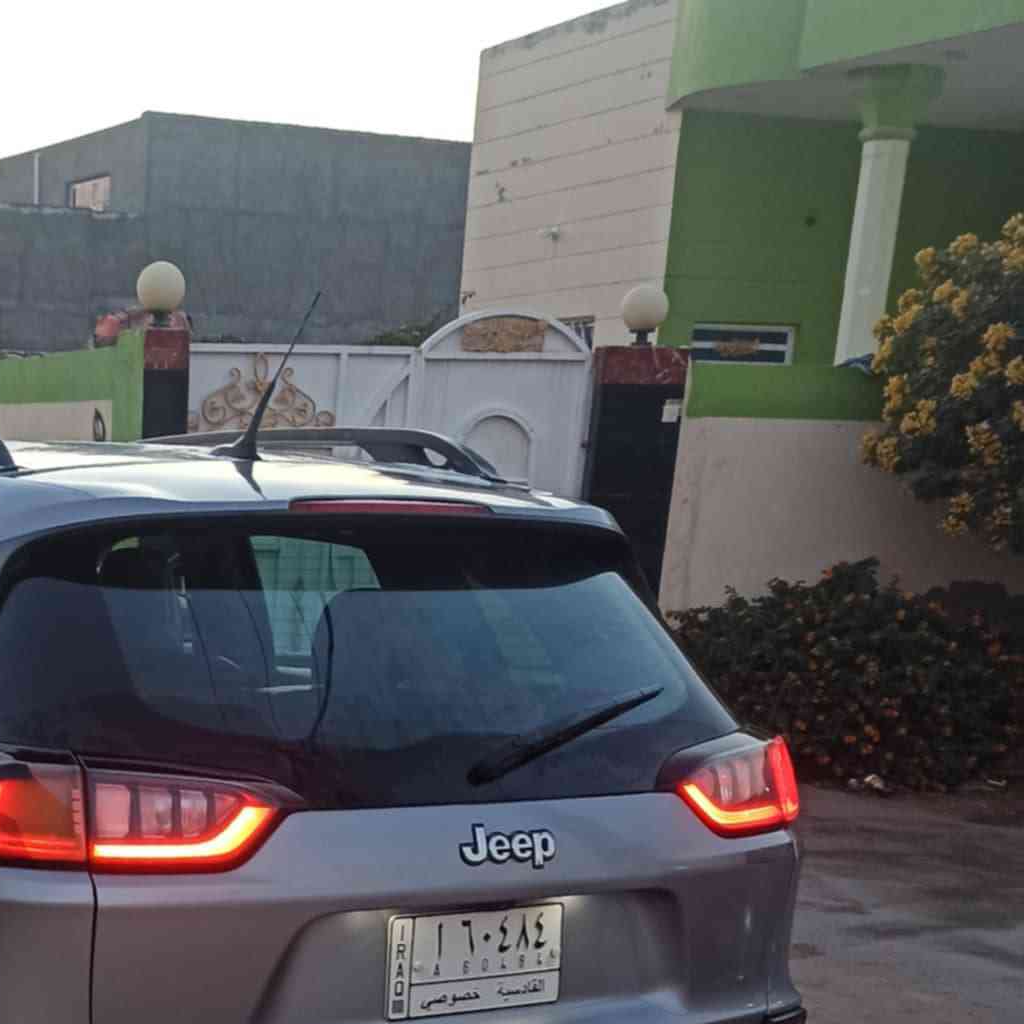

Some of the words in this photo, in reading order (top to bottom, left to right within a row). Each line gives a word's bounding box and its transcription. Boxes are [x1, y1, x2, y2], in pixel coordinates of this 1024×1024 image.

[461, 823, 556, 868] Jeep
[461, 912, 545, 955] ٦٠٤٨٤
[394, 925, 407, 996] IRAQ
[420, 988, 480, 1010] خصوصي
[497, 978, 544, 1001] القادسية
